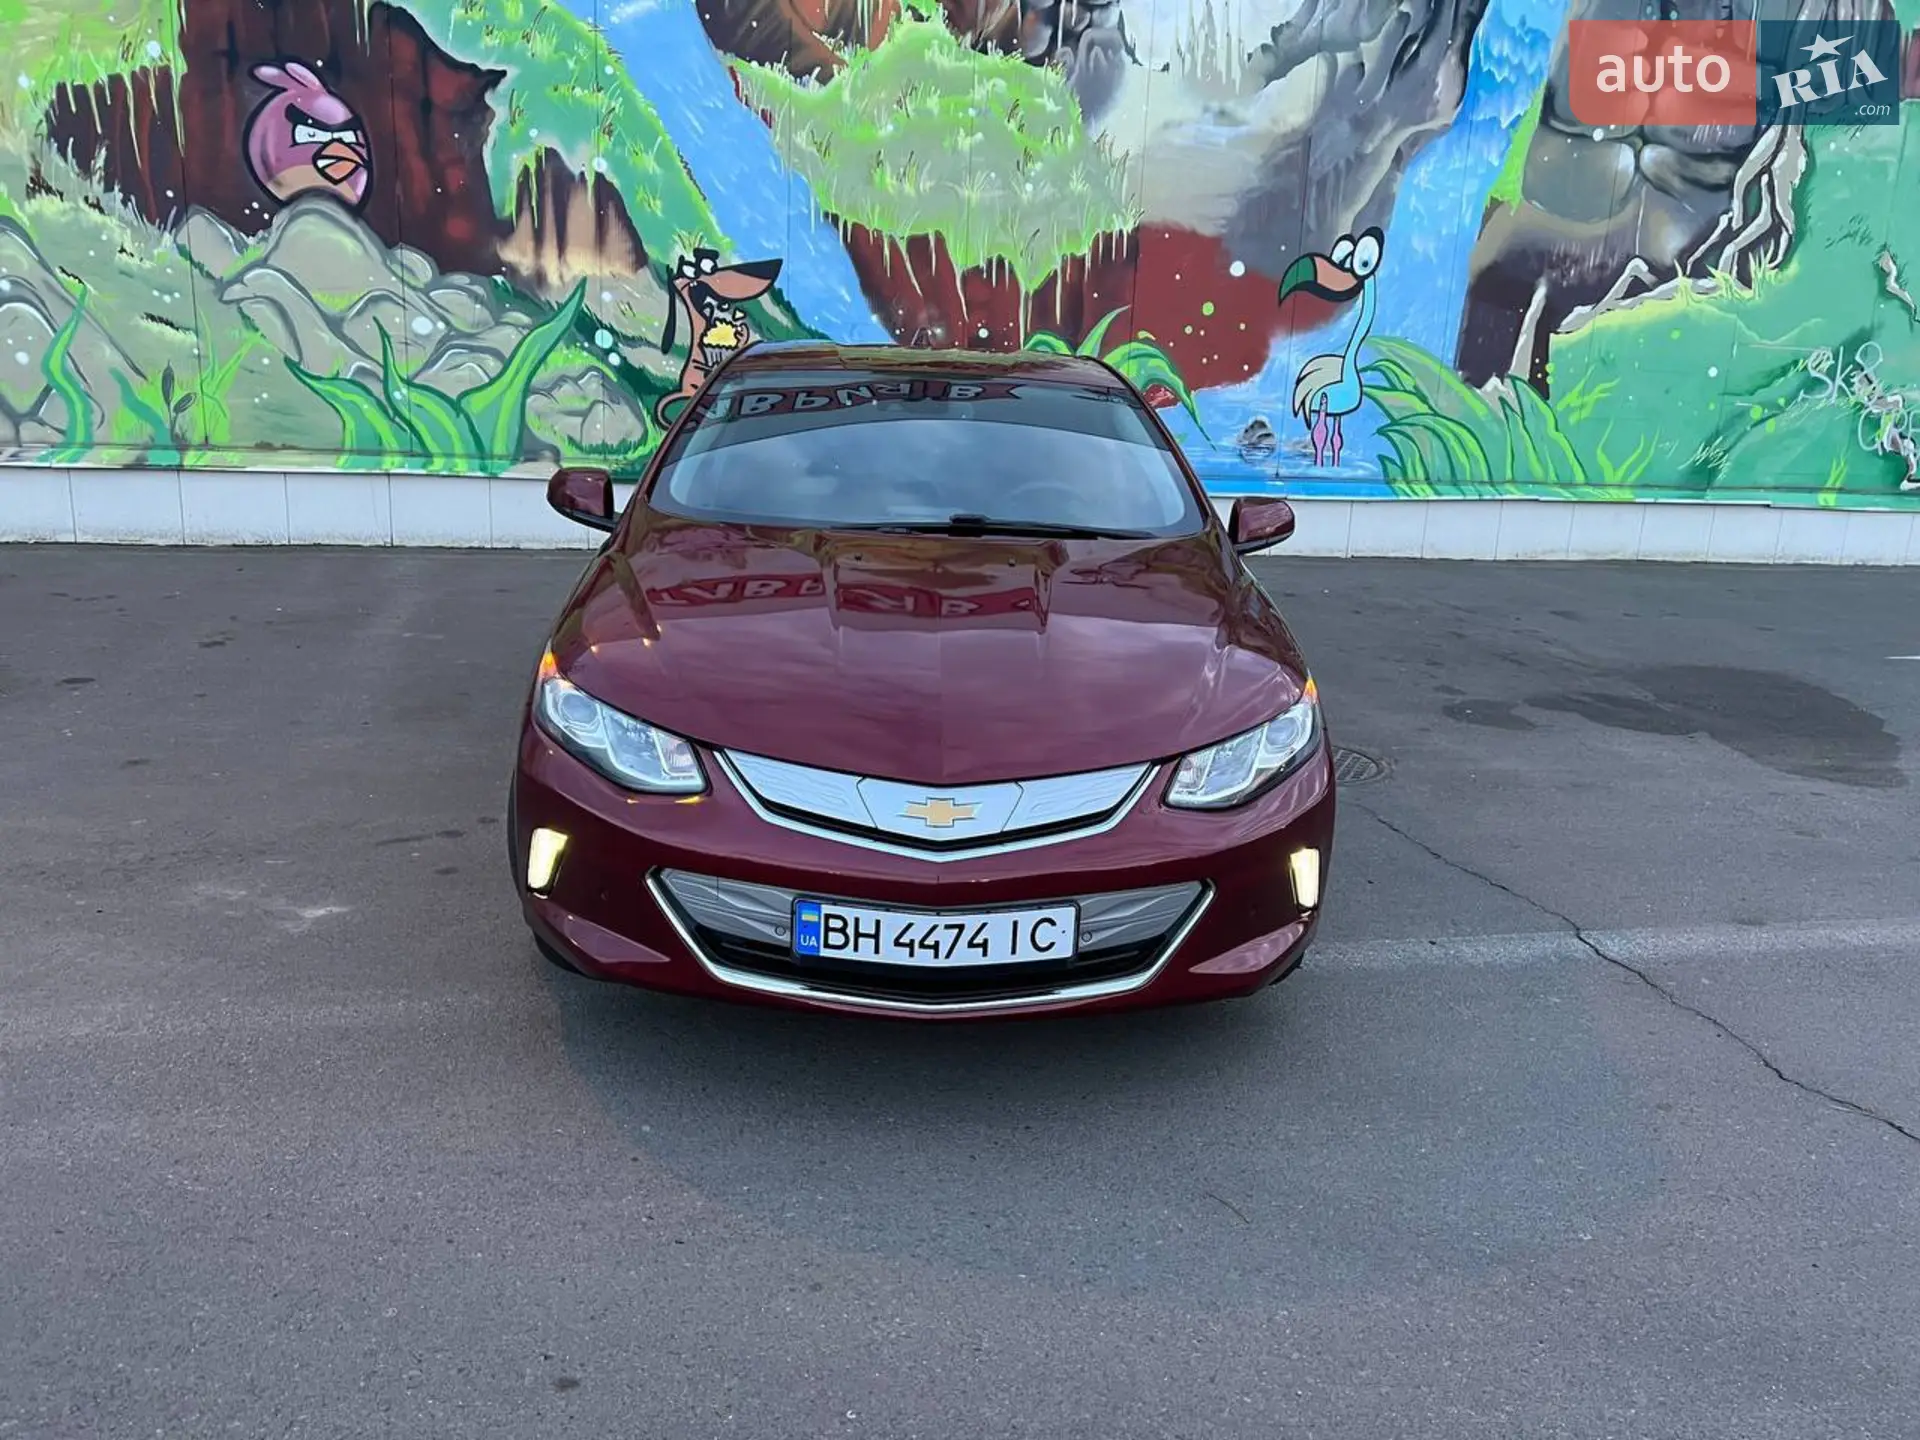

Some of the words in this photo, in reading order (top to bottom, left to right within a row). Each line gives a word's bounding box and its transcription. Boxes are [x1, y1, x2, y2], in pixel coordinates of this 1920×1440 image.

[801, 934, 818, 947] UA
[823, 913, 881, 955] BH
[893, 922, 989, 959] 4474
[1010, 917, 1057, 955] IC
